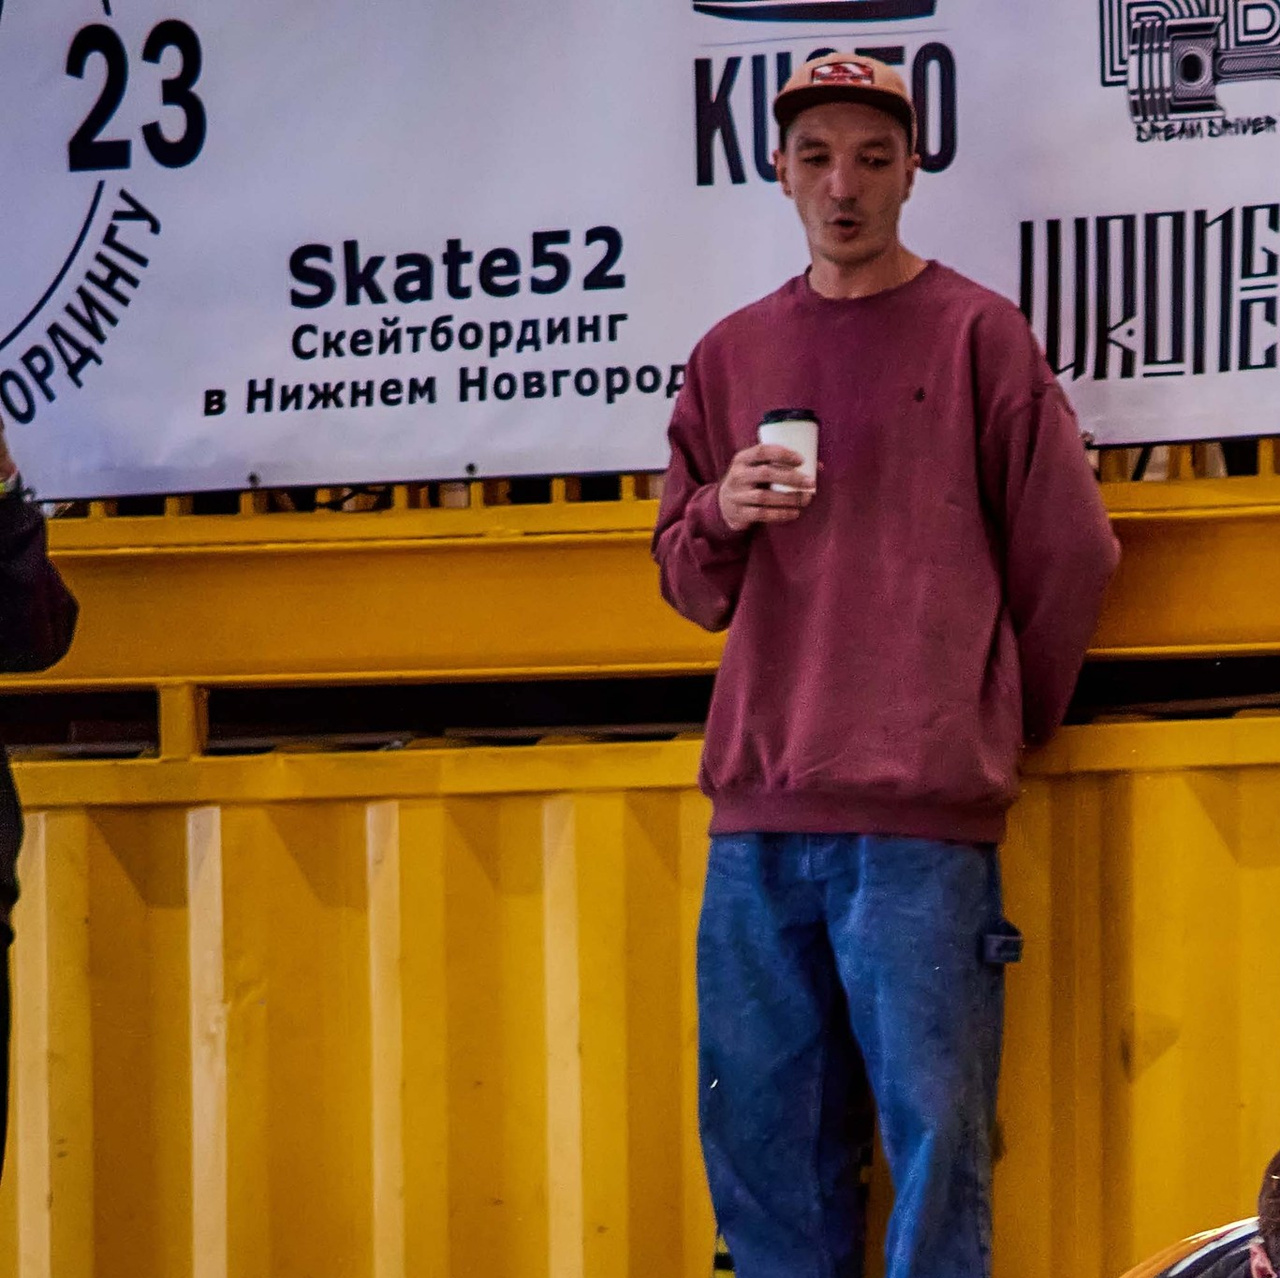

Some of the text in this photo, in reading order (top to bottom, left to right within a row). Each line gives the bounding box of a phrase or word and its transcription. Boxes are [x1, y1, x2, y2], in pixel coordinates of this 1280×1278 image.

[66, 19, 207, 172] 23
[695, 42, 957, 186] KUO
[289, 226, 626, 308] Skate52
[291, 313, 629, 360] Скейтбординг
[204, 362, 690, 416] в Нижнем Новгород
